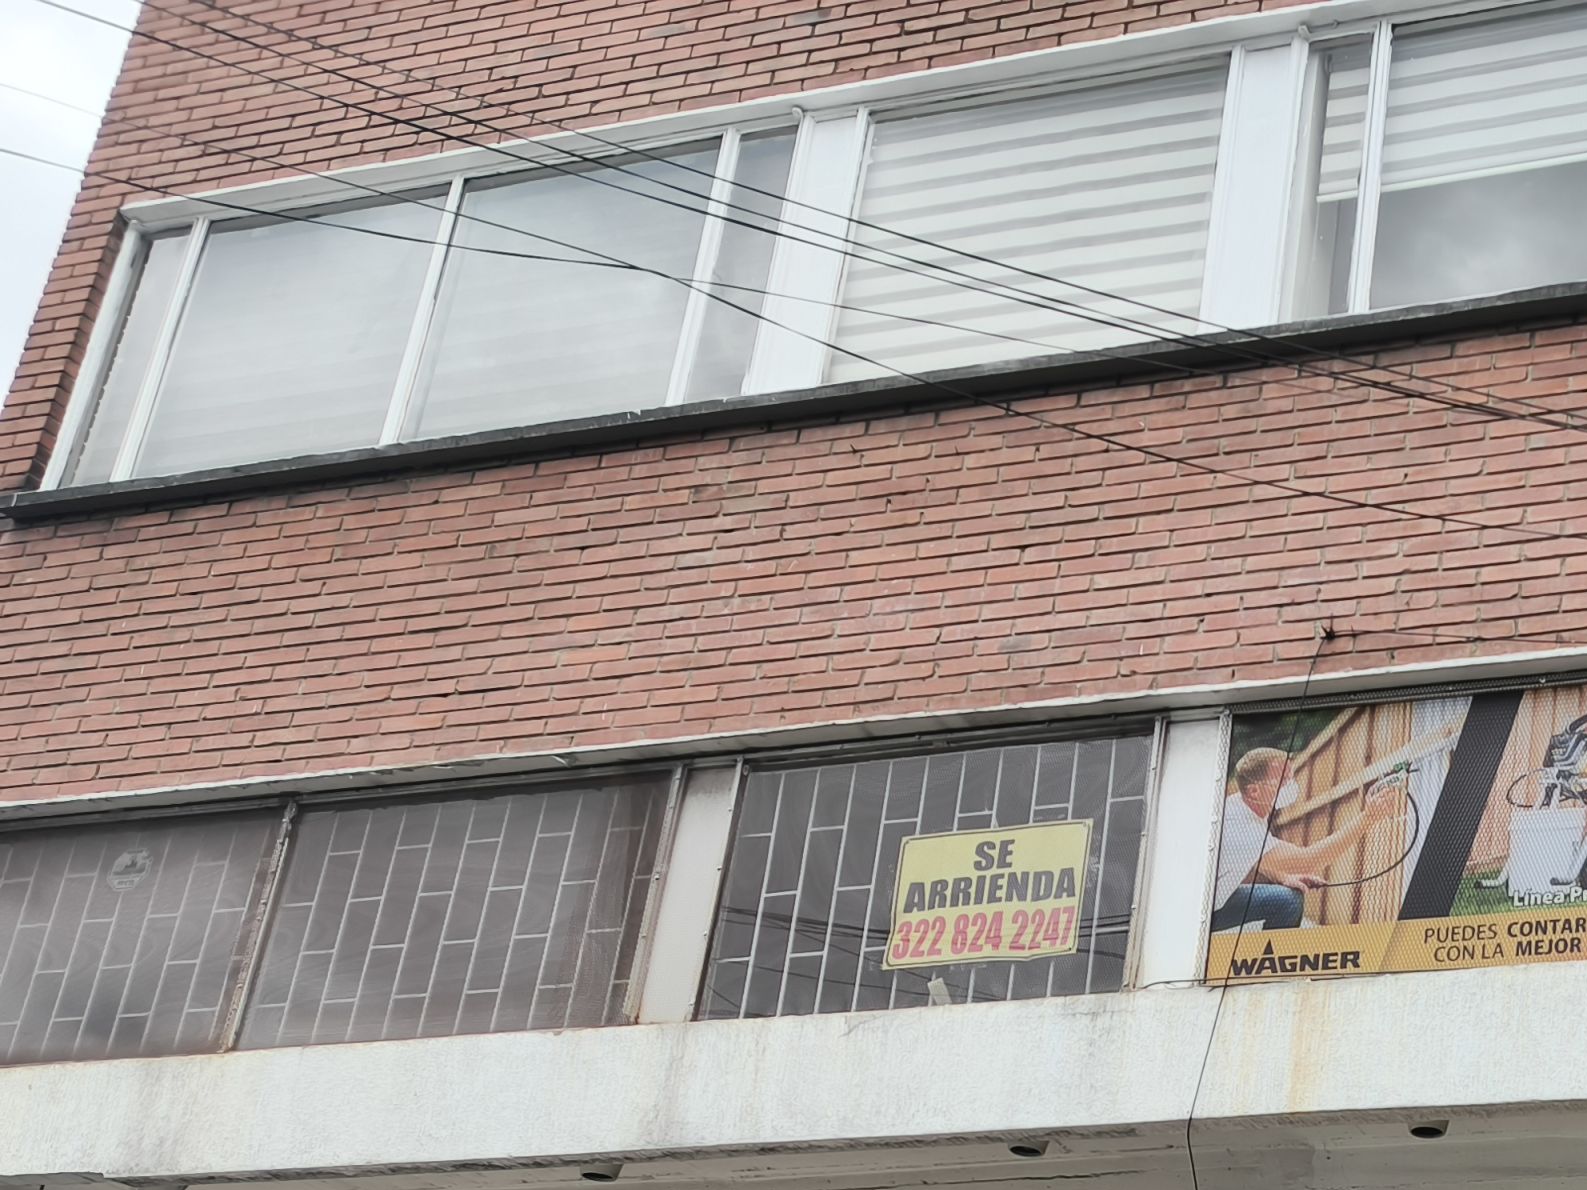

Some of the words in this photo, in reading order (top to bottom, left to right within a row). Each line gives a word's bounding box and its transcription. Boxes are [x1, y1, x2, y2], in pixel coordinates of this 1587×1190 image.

[973, 838, 1016, 872] SE
[903, 867, 1076, 914] ARRIENDA
[1513, 887, 1565, 908] Línea
[892, 915, 946, 960] 322
[950, 911, 1004, 956] 824
[1009, 905, 1076, 951] 2247
[1423, 923, 1498, 944] PUEDES
[1507, 917, 1587, 938] CONTAR
[1232, 938, 1361, 976] WAGNER
[1434, 945, 1475, 962] CON
[1481, 943, 1504, 959] LA
[1515, 937, 1581, 957] MEJOR
